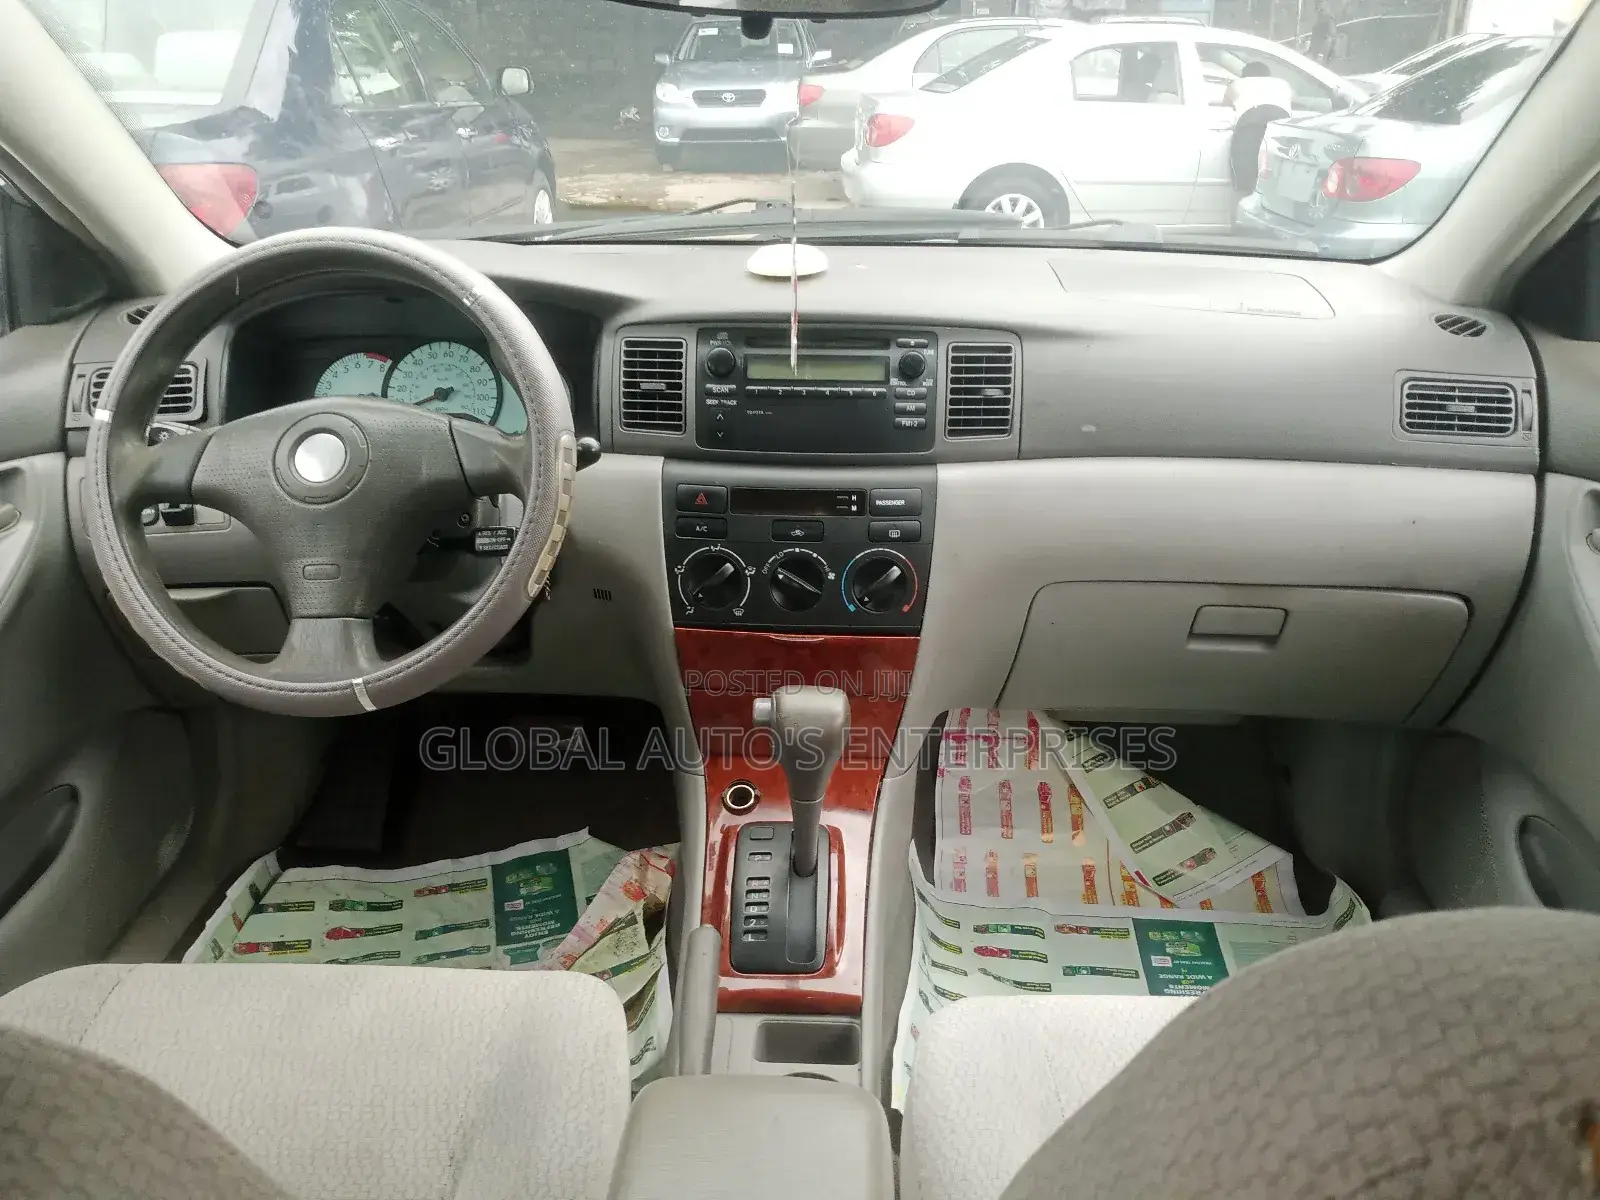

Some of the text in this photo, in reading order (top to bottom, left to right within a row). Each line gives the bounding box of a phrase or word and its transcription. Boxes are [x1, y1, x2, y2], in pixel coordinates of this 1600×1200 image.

[427, 351, 438, 359] 50
[459, 355, 469, 363] 70
[354, 360, 361, 369] 6
[367, 360, 374, 368] 7
[412, 359, 423, 367] 40
[343, 364, 350, 374] 5
[379, 363, 386, 372] 8
[469, 365, 480, 373] 80
[402, 371, 413, 379] 30
[325, 381, 332, 390] 3
[473, 407, 486, 415] 110
[761, 563, 771, 575] OFF
[775, 551, 785, 559] LO
